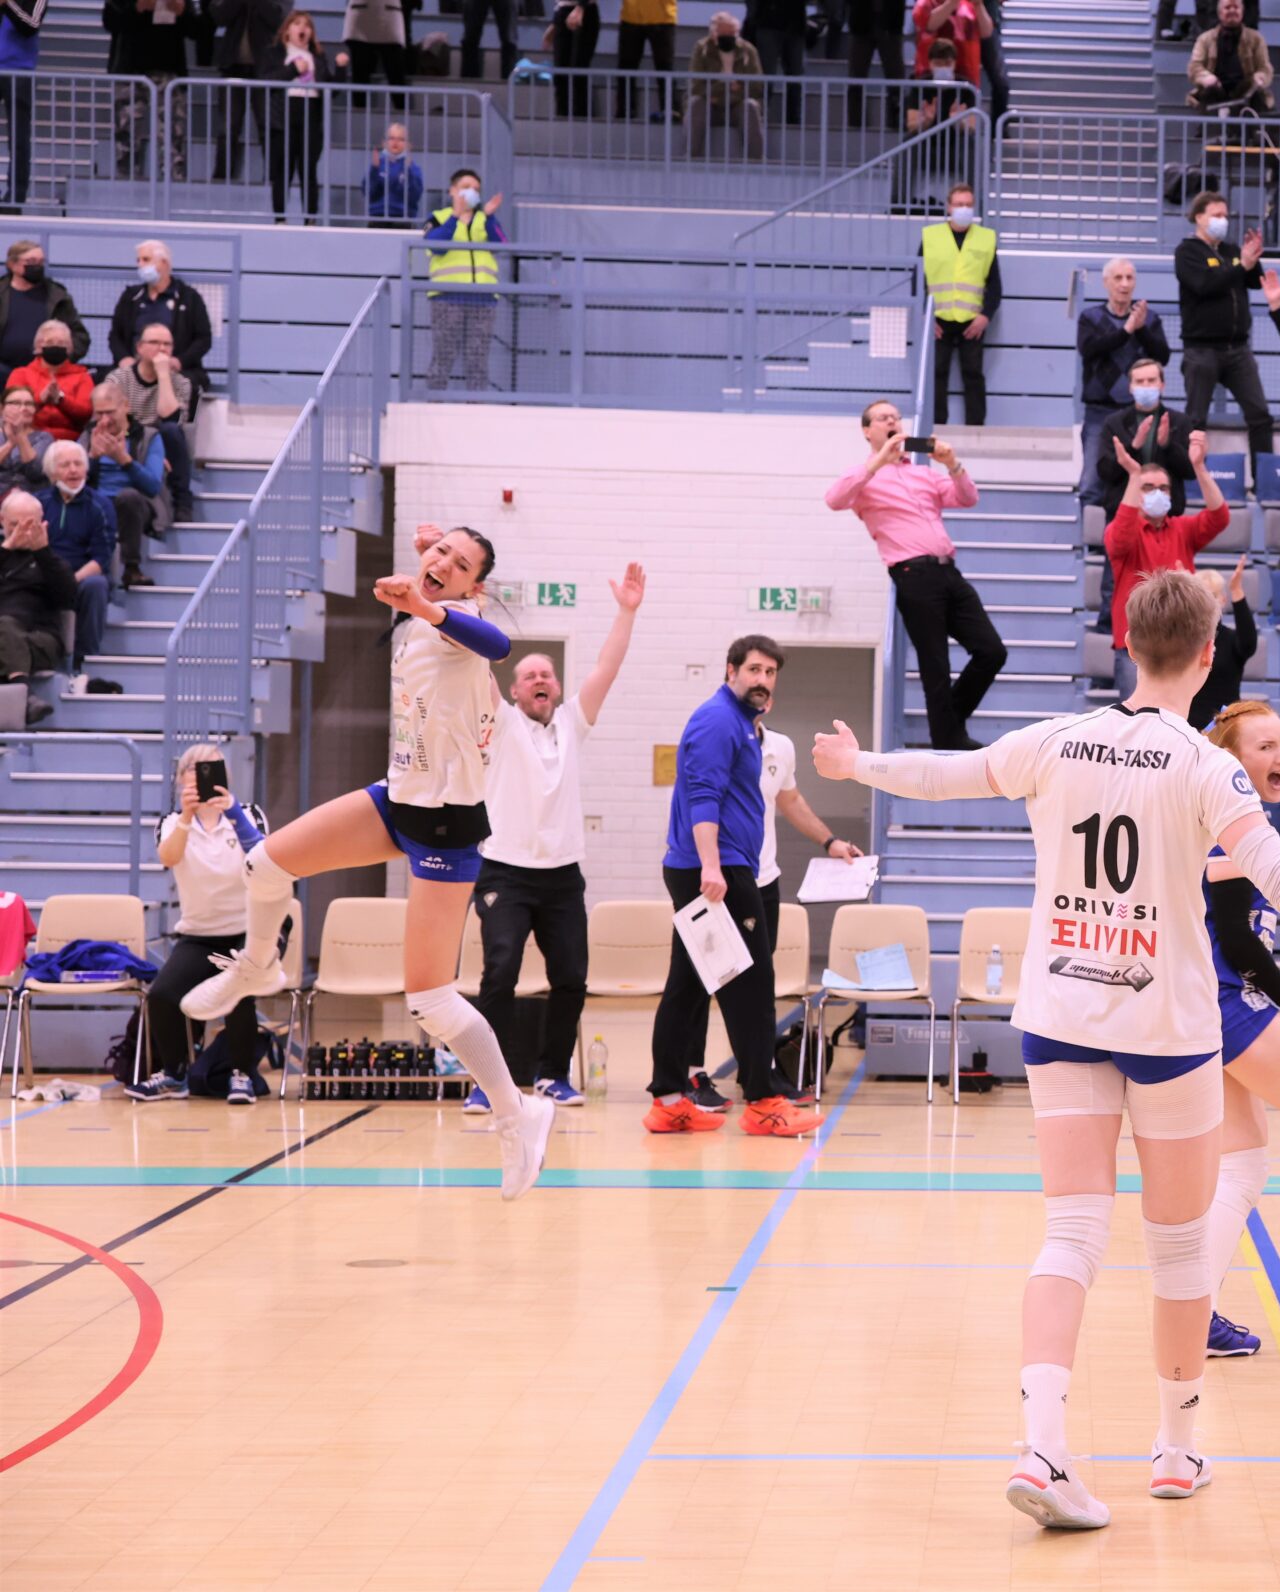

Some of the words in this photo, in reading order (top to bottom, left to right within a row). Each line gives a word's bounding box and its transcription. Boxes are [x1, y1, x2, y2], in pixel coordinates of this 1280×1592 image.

[1060, 740, 1172, 770] RINTA-TASSI
[419, 861, 446, 871] CRAFT
[1072, 812, 1140, 894] 10
[1050, 917, 1157, 958] ELIVIN
